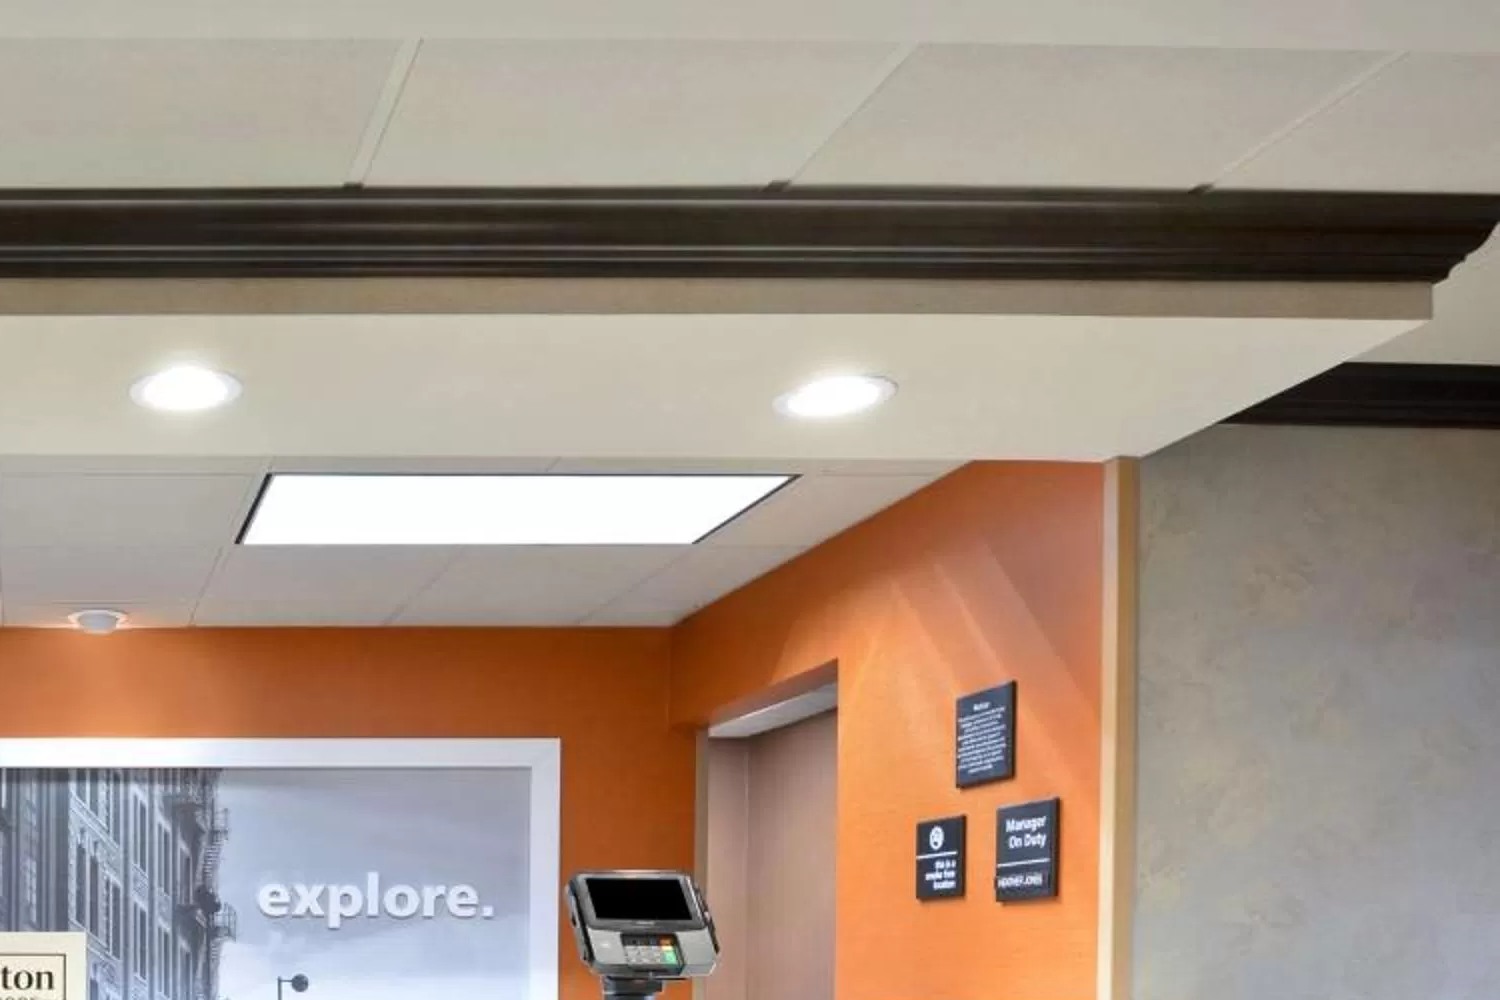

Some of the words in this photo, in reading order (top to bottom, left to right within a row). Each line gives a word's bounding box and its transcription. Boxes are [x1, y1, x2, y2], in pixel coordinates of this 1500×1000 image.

[1005, 815, 1047, 832] Manager
[1008, 835, 1022, 848] On
[1023, 832, 1047, 848] Duty
[257, 871, 495, 930] explore.
